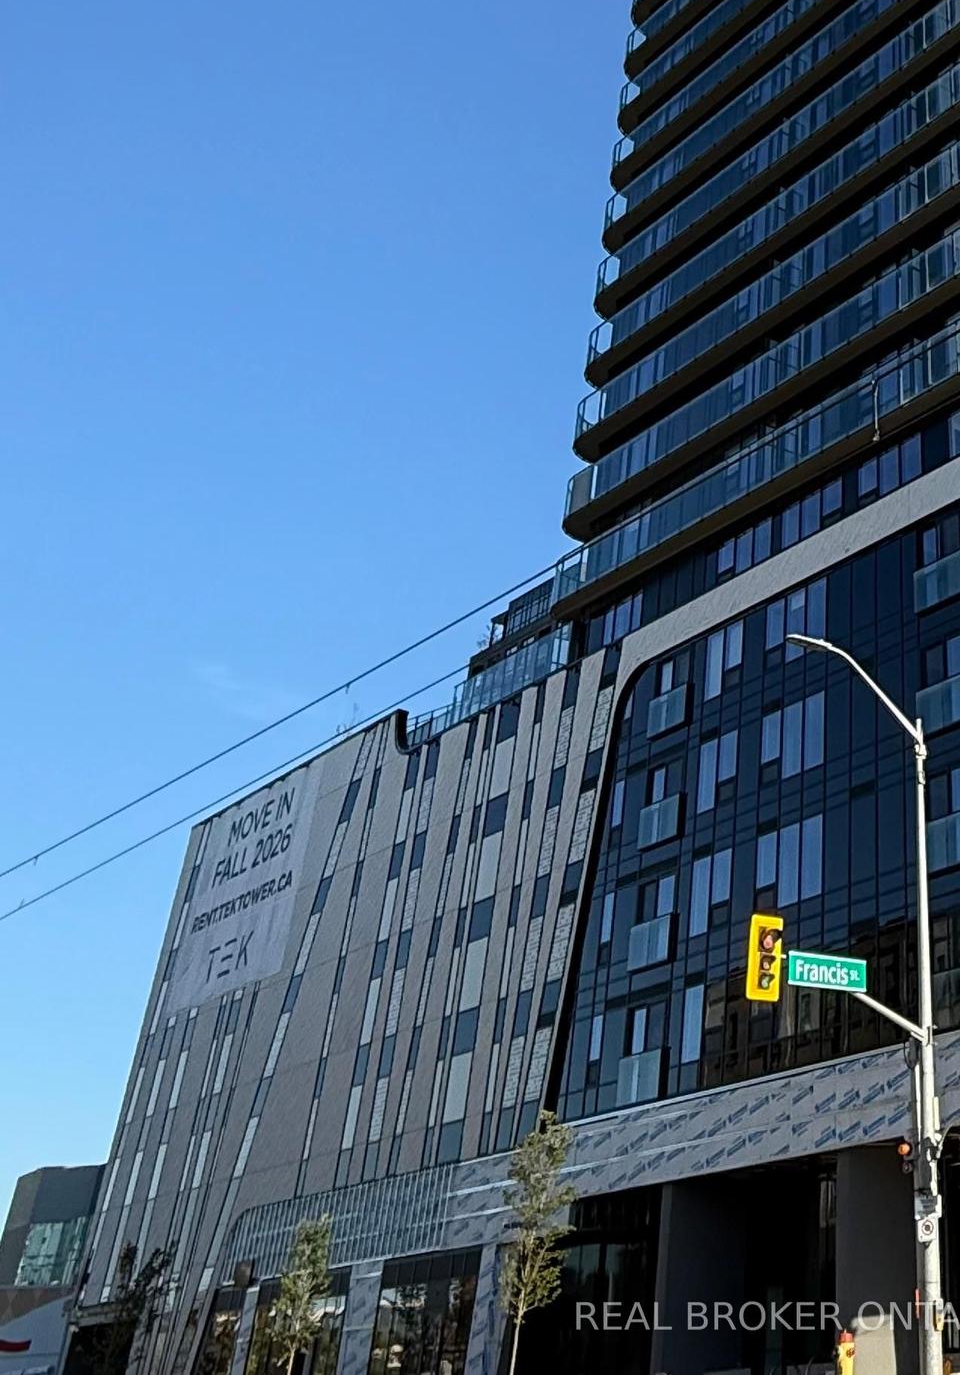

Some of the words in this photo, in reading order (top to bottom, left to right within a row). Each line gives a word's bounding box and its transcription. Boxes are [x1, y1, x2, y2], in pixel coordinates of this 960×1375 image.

[227, 800, 276, 847] MOVE
[275, 787, 296, 822] IN
[210, 851, 248, 889] FALL
[251, 823, 293, 866] 2026
[795, 959, 849, 986] Francis
